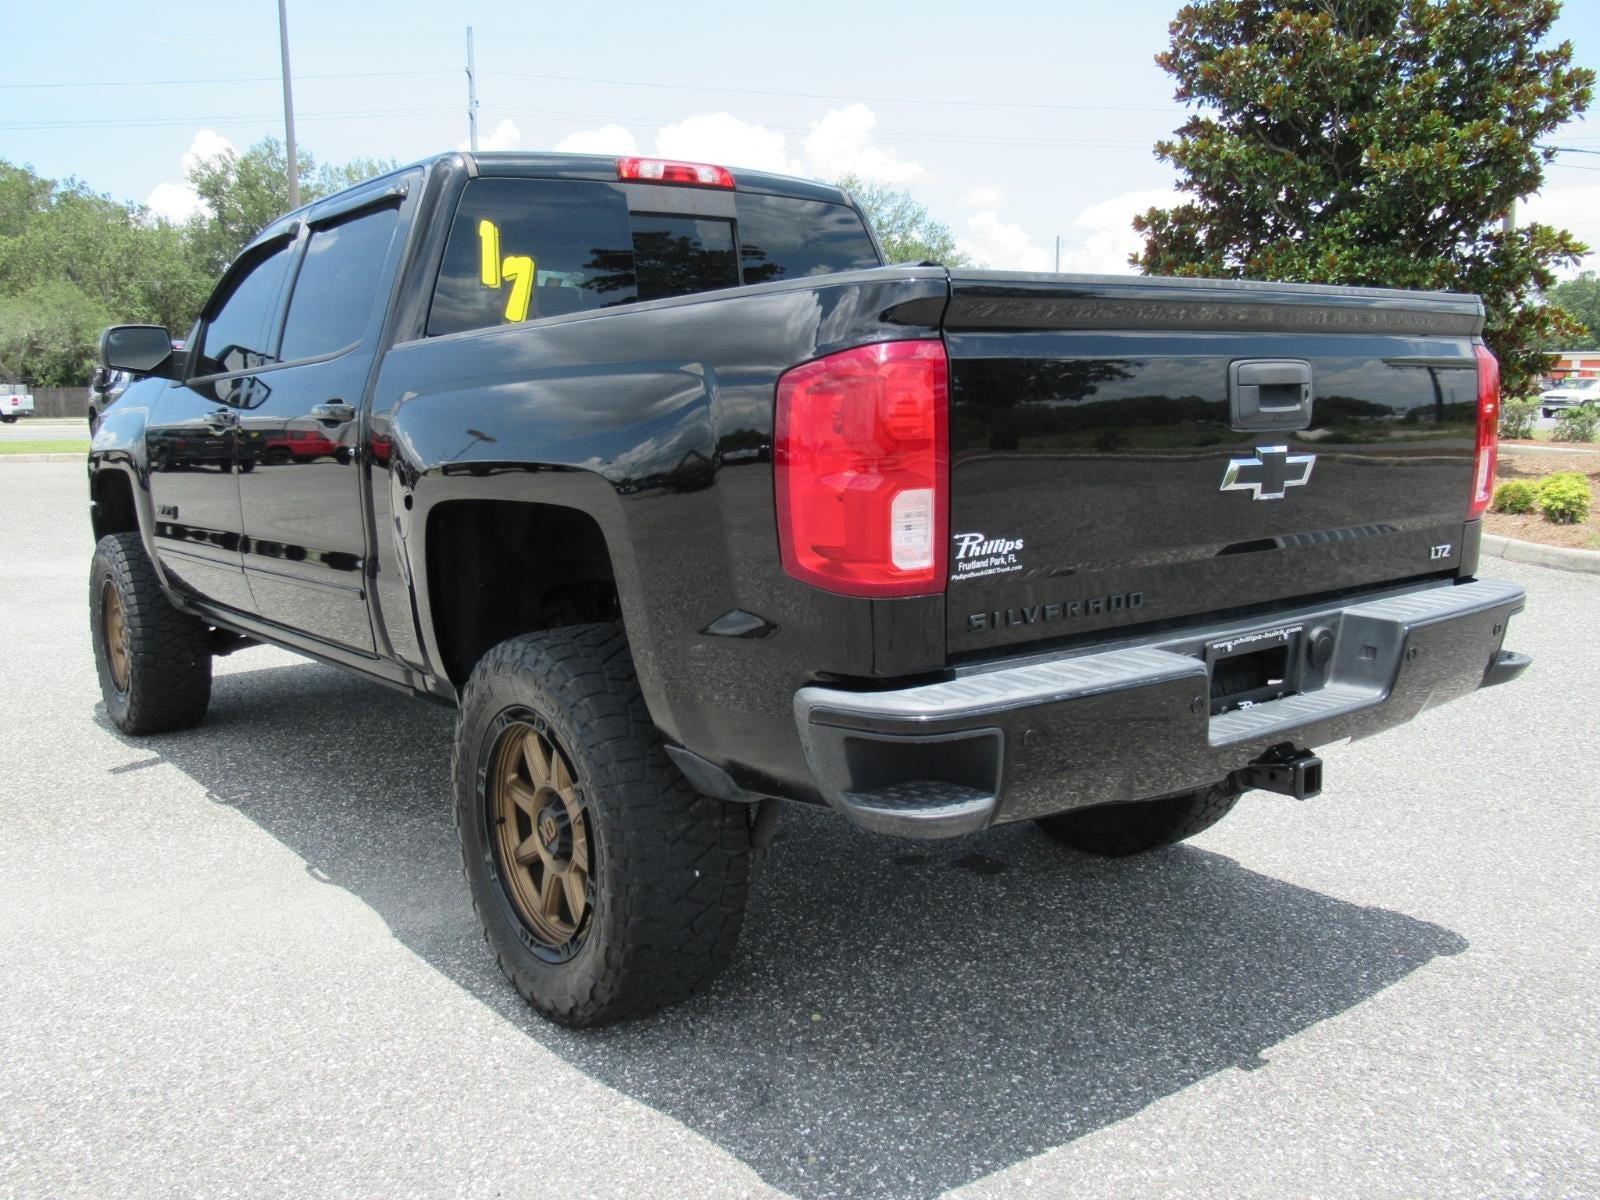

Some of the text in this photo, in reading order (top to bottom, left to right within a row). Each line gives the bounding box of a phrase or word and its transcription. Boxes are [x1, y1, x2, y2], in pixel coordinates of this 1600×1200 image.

[479, 220, 535, 323] 17
[953, 533, 1024, 559] Phillips
[1430, 544, 1451, 560] LTZ
[958, 553, 1017, 572] Fruitland Park, FL
[967, 591, 1145, 633] SILVERADO
